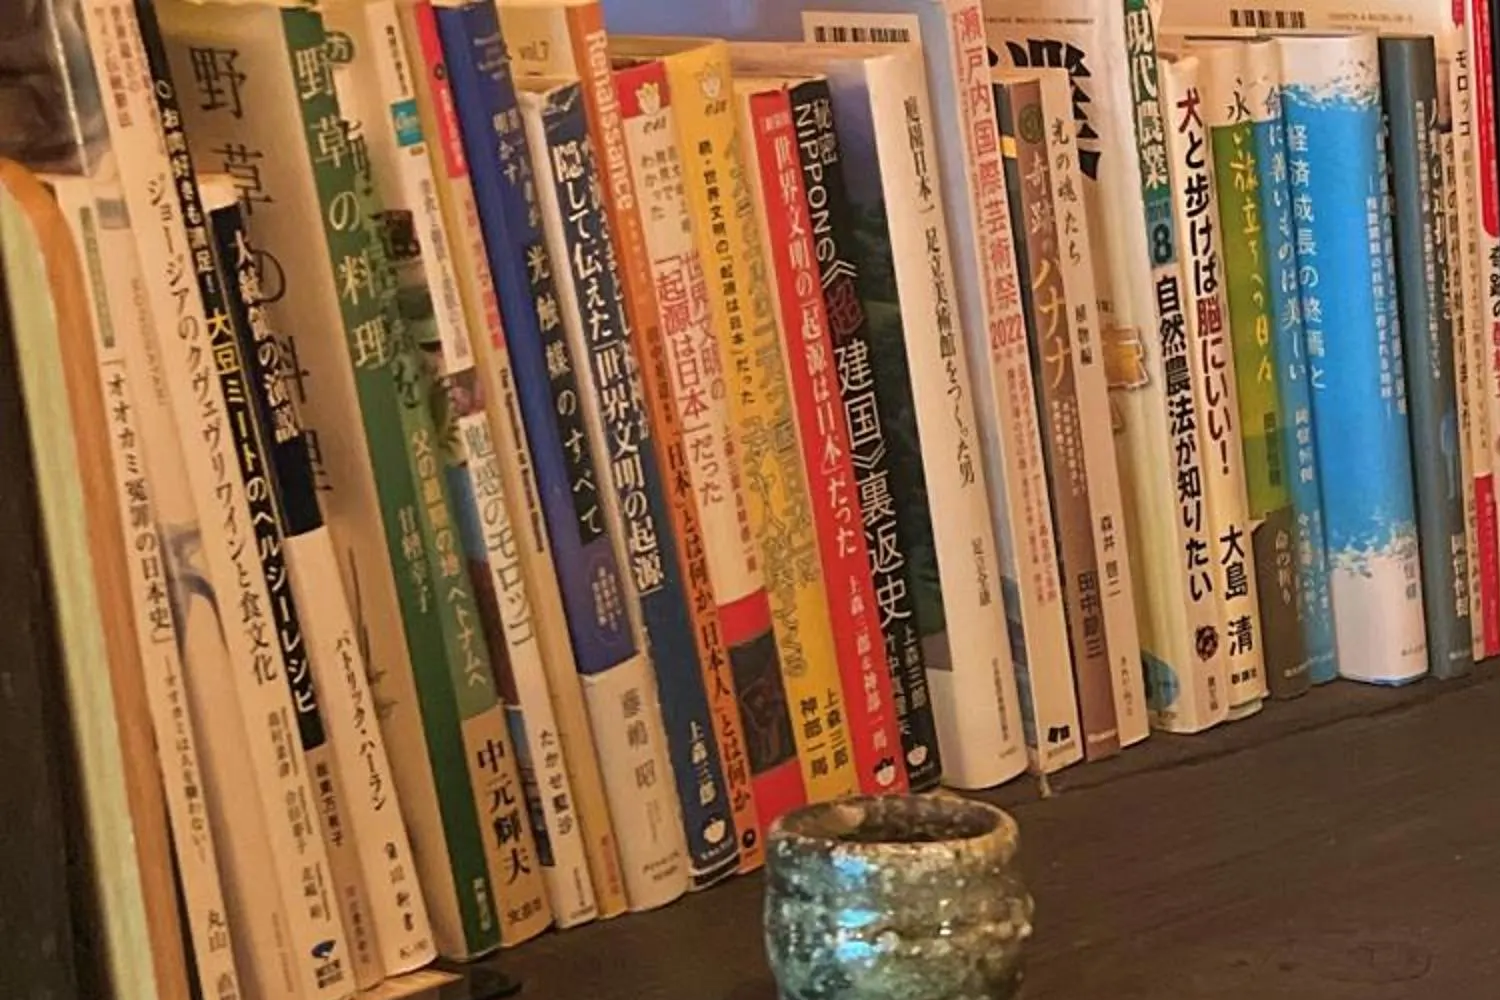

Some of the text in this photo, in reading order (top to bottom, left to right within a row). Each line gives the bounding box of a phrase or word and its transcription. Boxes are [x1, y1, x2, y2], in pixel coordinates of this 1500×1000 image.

[584, 31, 634, 211] Renaissance
[1125, 8, 1171, 191] 現代農業
[1152, 227, 1173, 265] 8
[989, 315, 1024, 350] 2022
[1156, 275, 1213, 602] 自然農法が知りたい
[1220, 525, 1253, 656] 大島 清
